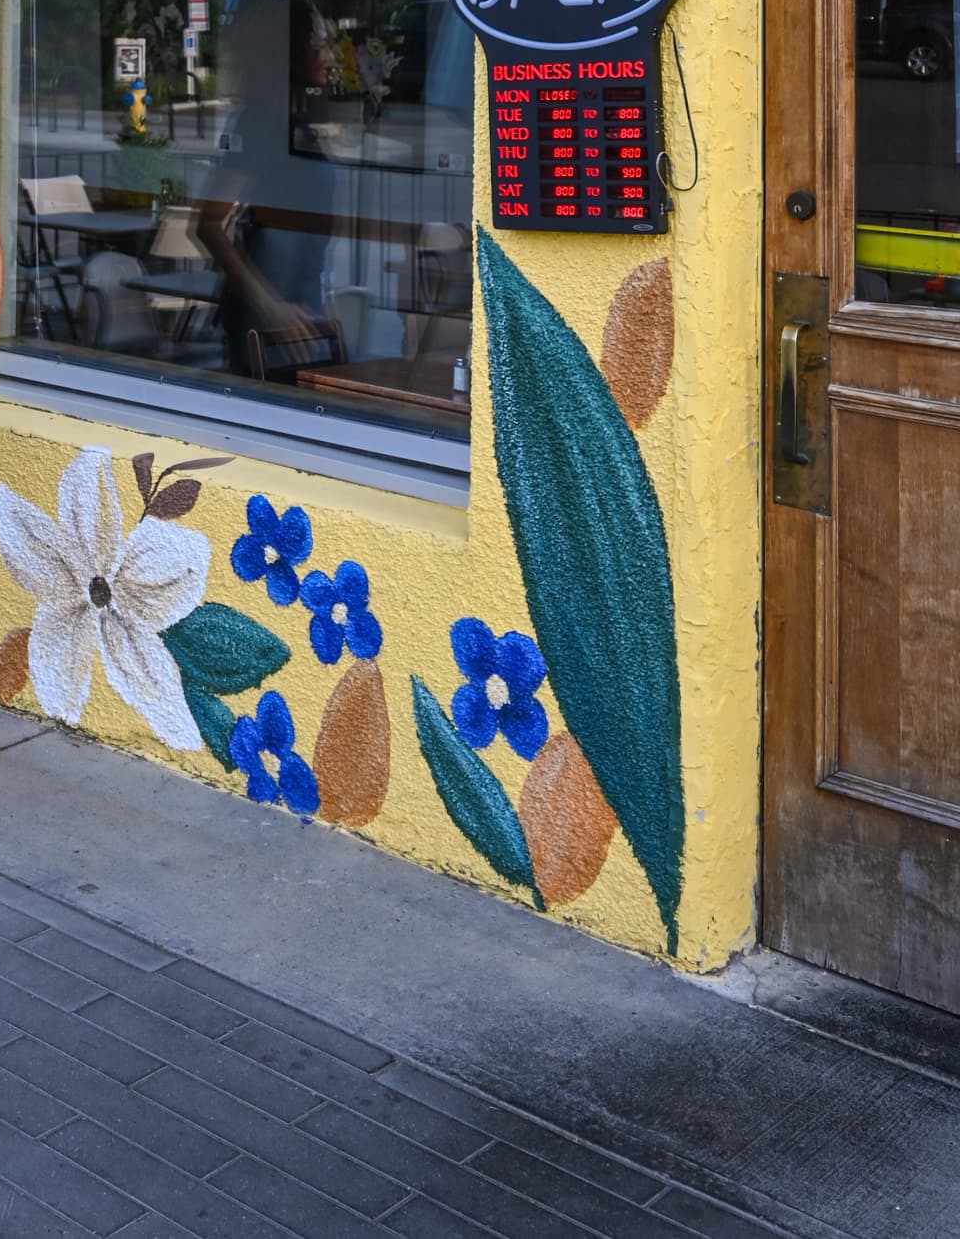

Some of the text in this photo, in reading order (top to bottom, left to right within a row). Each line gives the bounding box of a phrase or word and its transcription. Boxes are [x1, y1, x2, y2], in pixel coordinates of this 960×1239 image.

[493, 61, 645, 81] BUSINESS HOURS
[495, 89, 530, 103] MON
[496, 108, 523, 122] TUE
[583, 108, 598, 119] TO
[497, 127, 530, 140] WED
[583, 128, 598, 139] TO
[497, 146, 527, 159] THU
[584, 147, 599, 157] TO
[497, 165, 519, 178] FRI
[585, 166, 600, 177] TO
[498, 184, 523, 197] SAT
[586, 186, 600, 197] TO
[499, 203, 529, 216] SUN
[586, 206, 601, 216] TO
